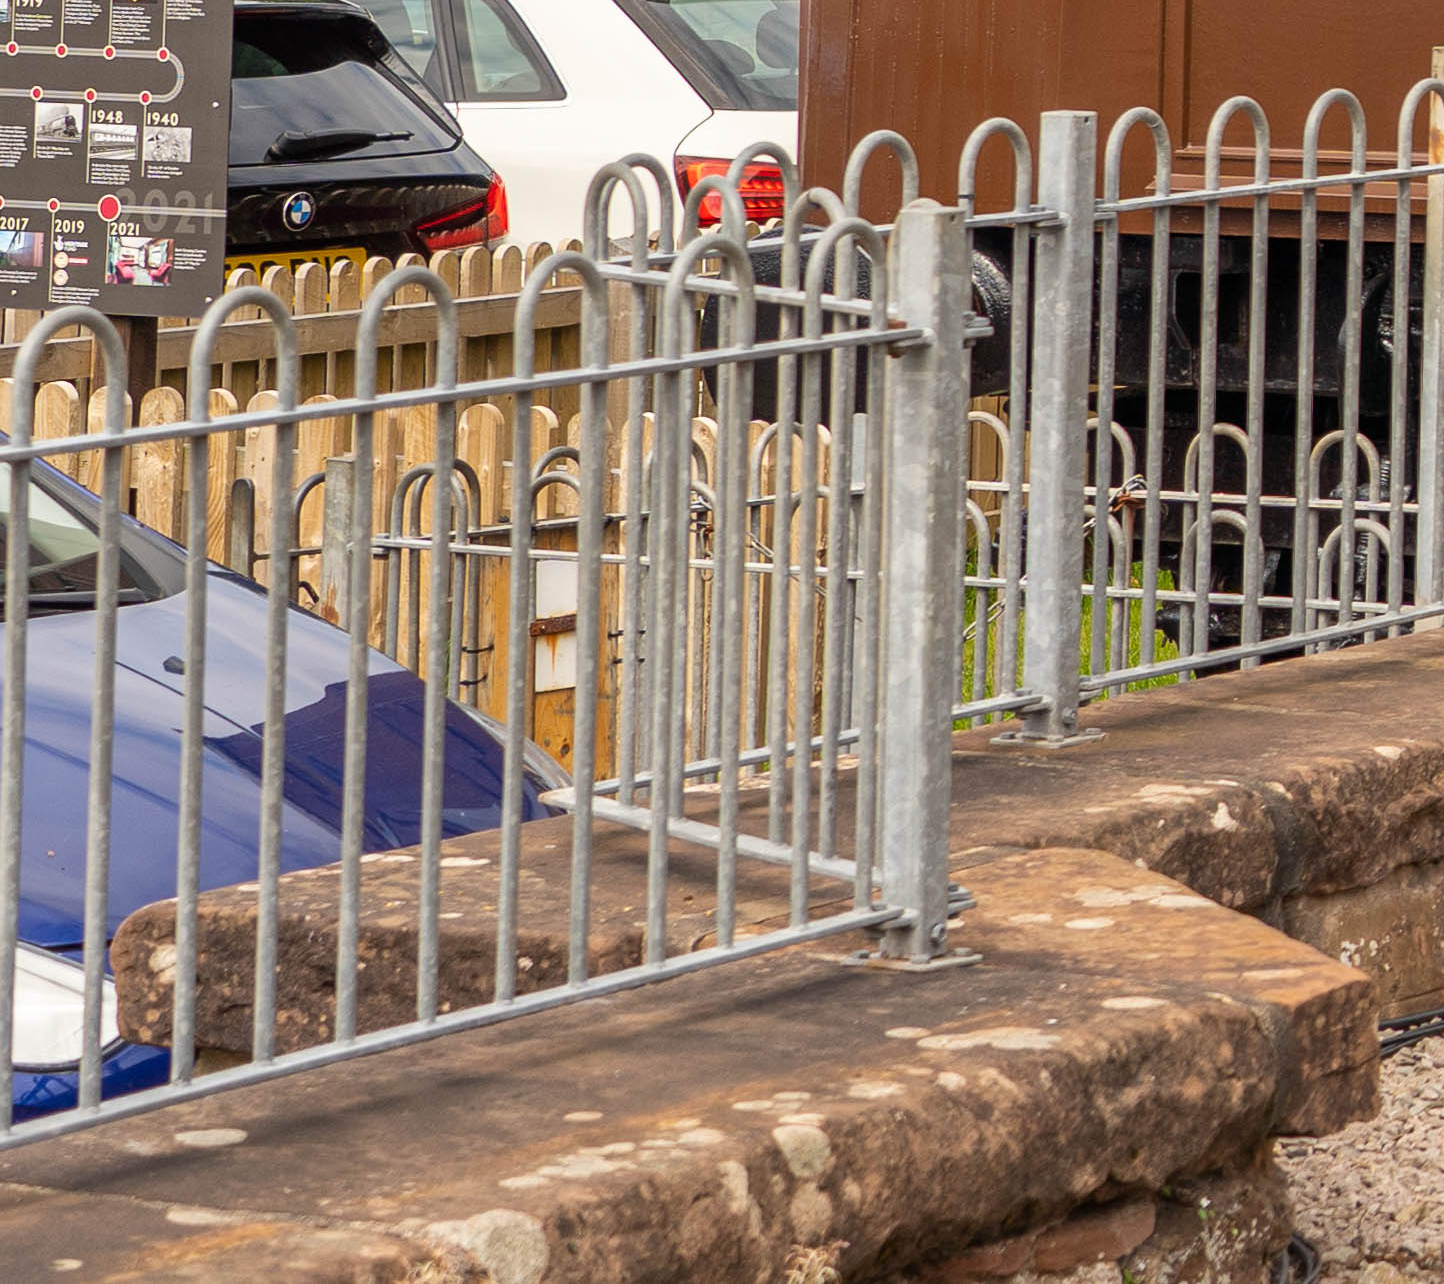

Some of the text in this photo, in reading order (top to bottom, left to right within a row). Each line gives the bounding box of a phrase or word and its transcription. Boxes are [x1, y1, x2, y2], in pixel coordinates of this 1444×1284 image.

[92, 109, 123, 123] 1948
[147, 112, 179, 126] 1940
[114, 187, 214, 234] 2021
[0, 216, 30, 231] 2017
[54, 219, 85, 233] 2019
[110, 222, 140, 236] 2021
